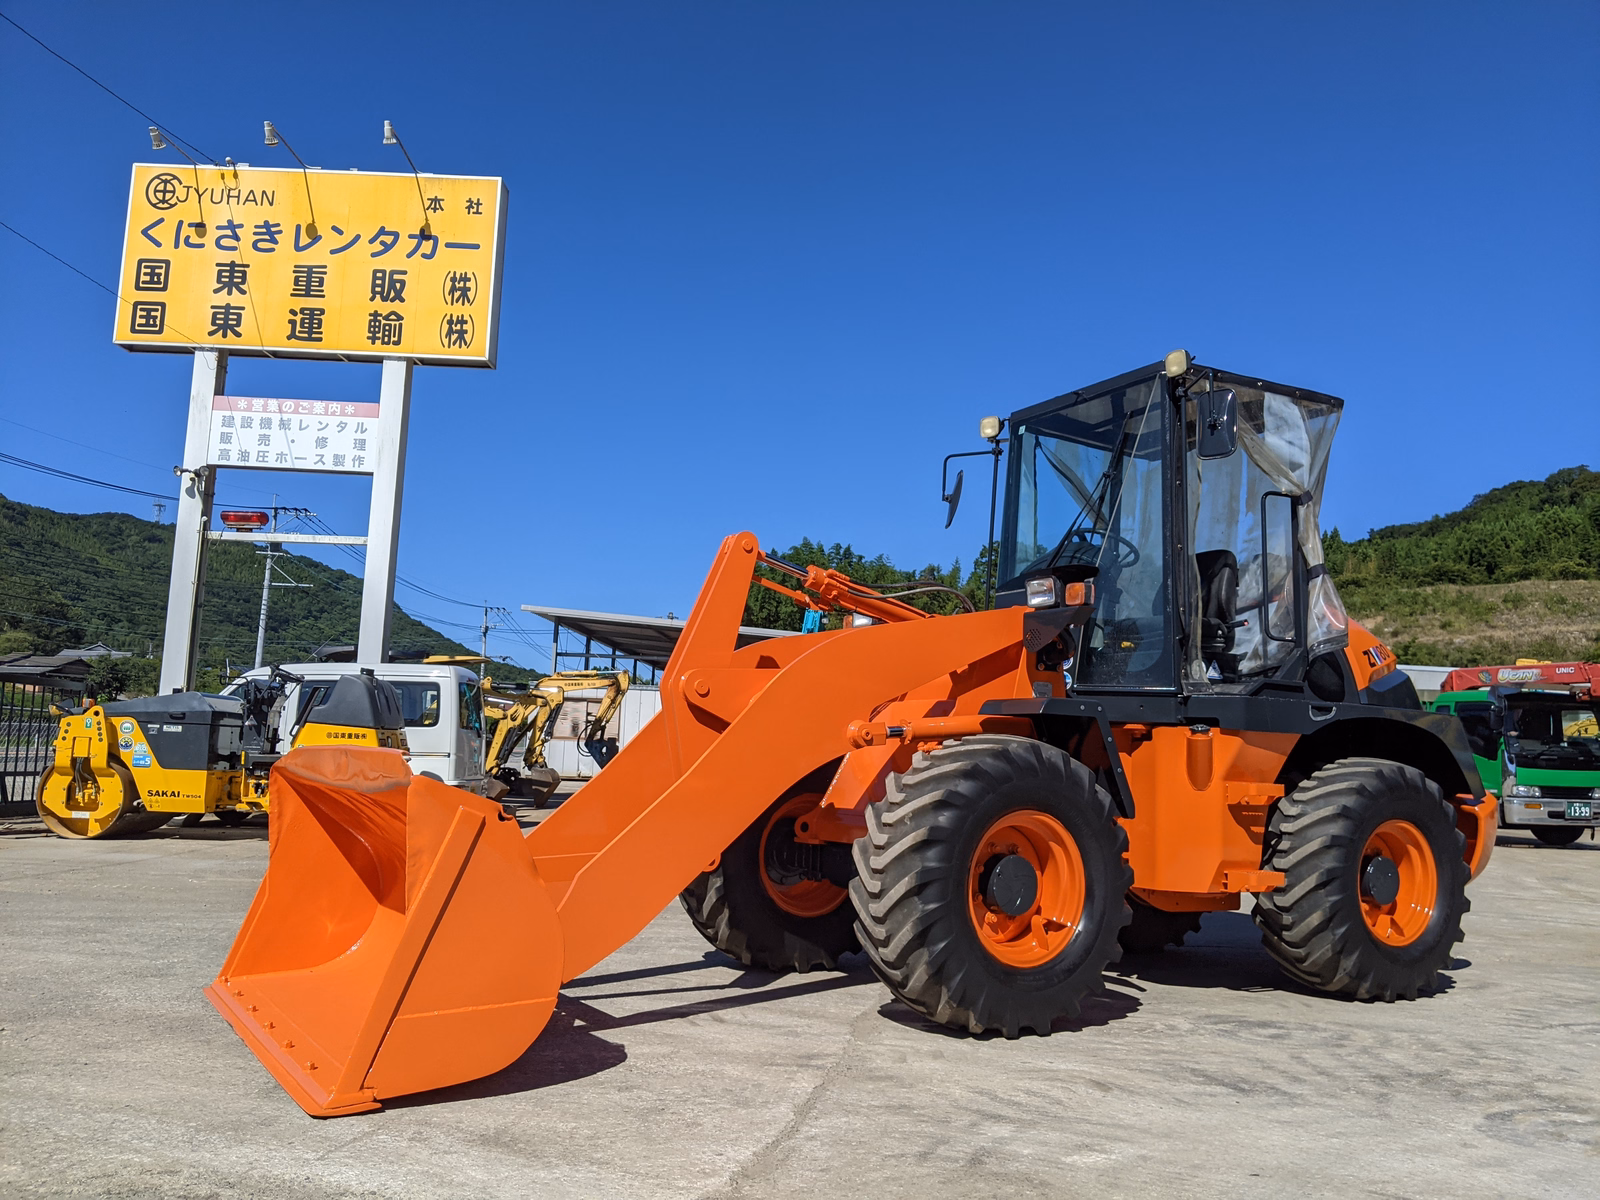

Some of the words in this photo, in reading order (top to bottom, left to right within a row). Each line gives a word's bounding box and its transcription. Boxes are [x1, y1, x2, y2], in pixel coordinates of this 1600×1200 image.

[176, 185, 275, 207] JYUHAN
[425, 194, 484, 216] 本社
[140, 216, 481, 261] くにさきレンタカー
[220, 414, 368, 435] 建設機械レンタル
[216, 447, 366, 469] 高油圧ホース製作
[147, 789, 181, 798] SAKAI
[1571, 806, 1590, 817] 13-99
